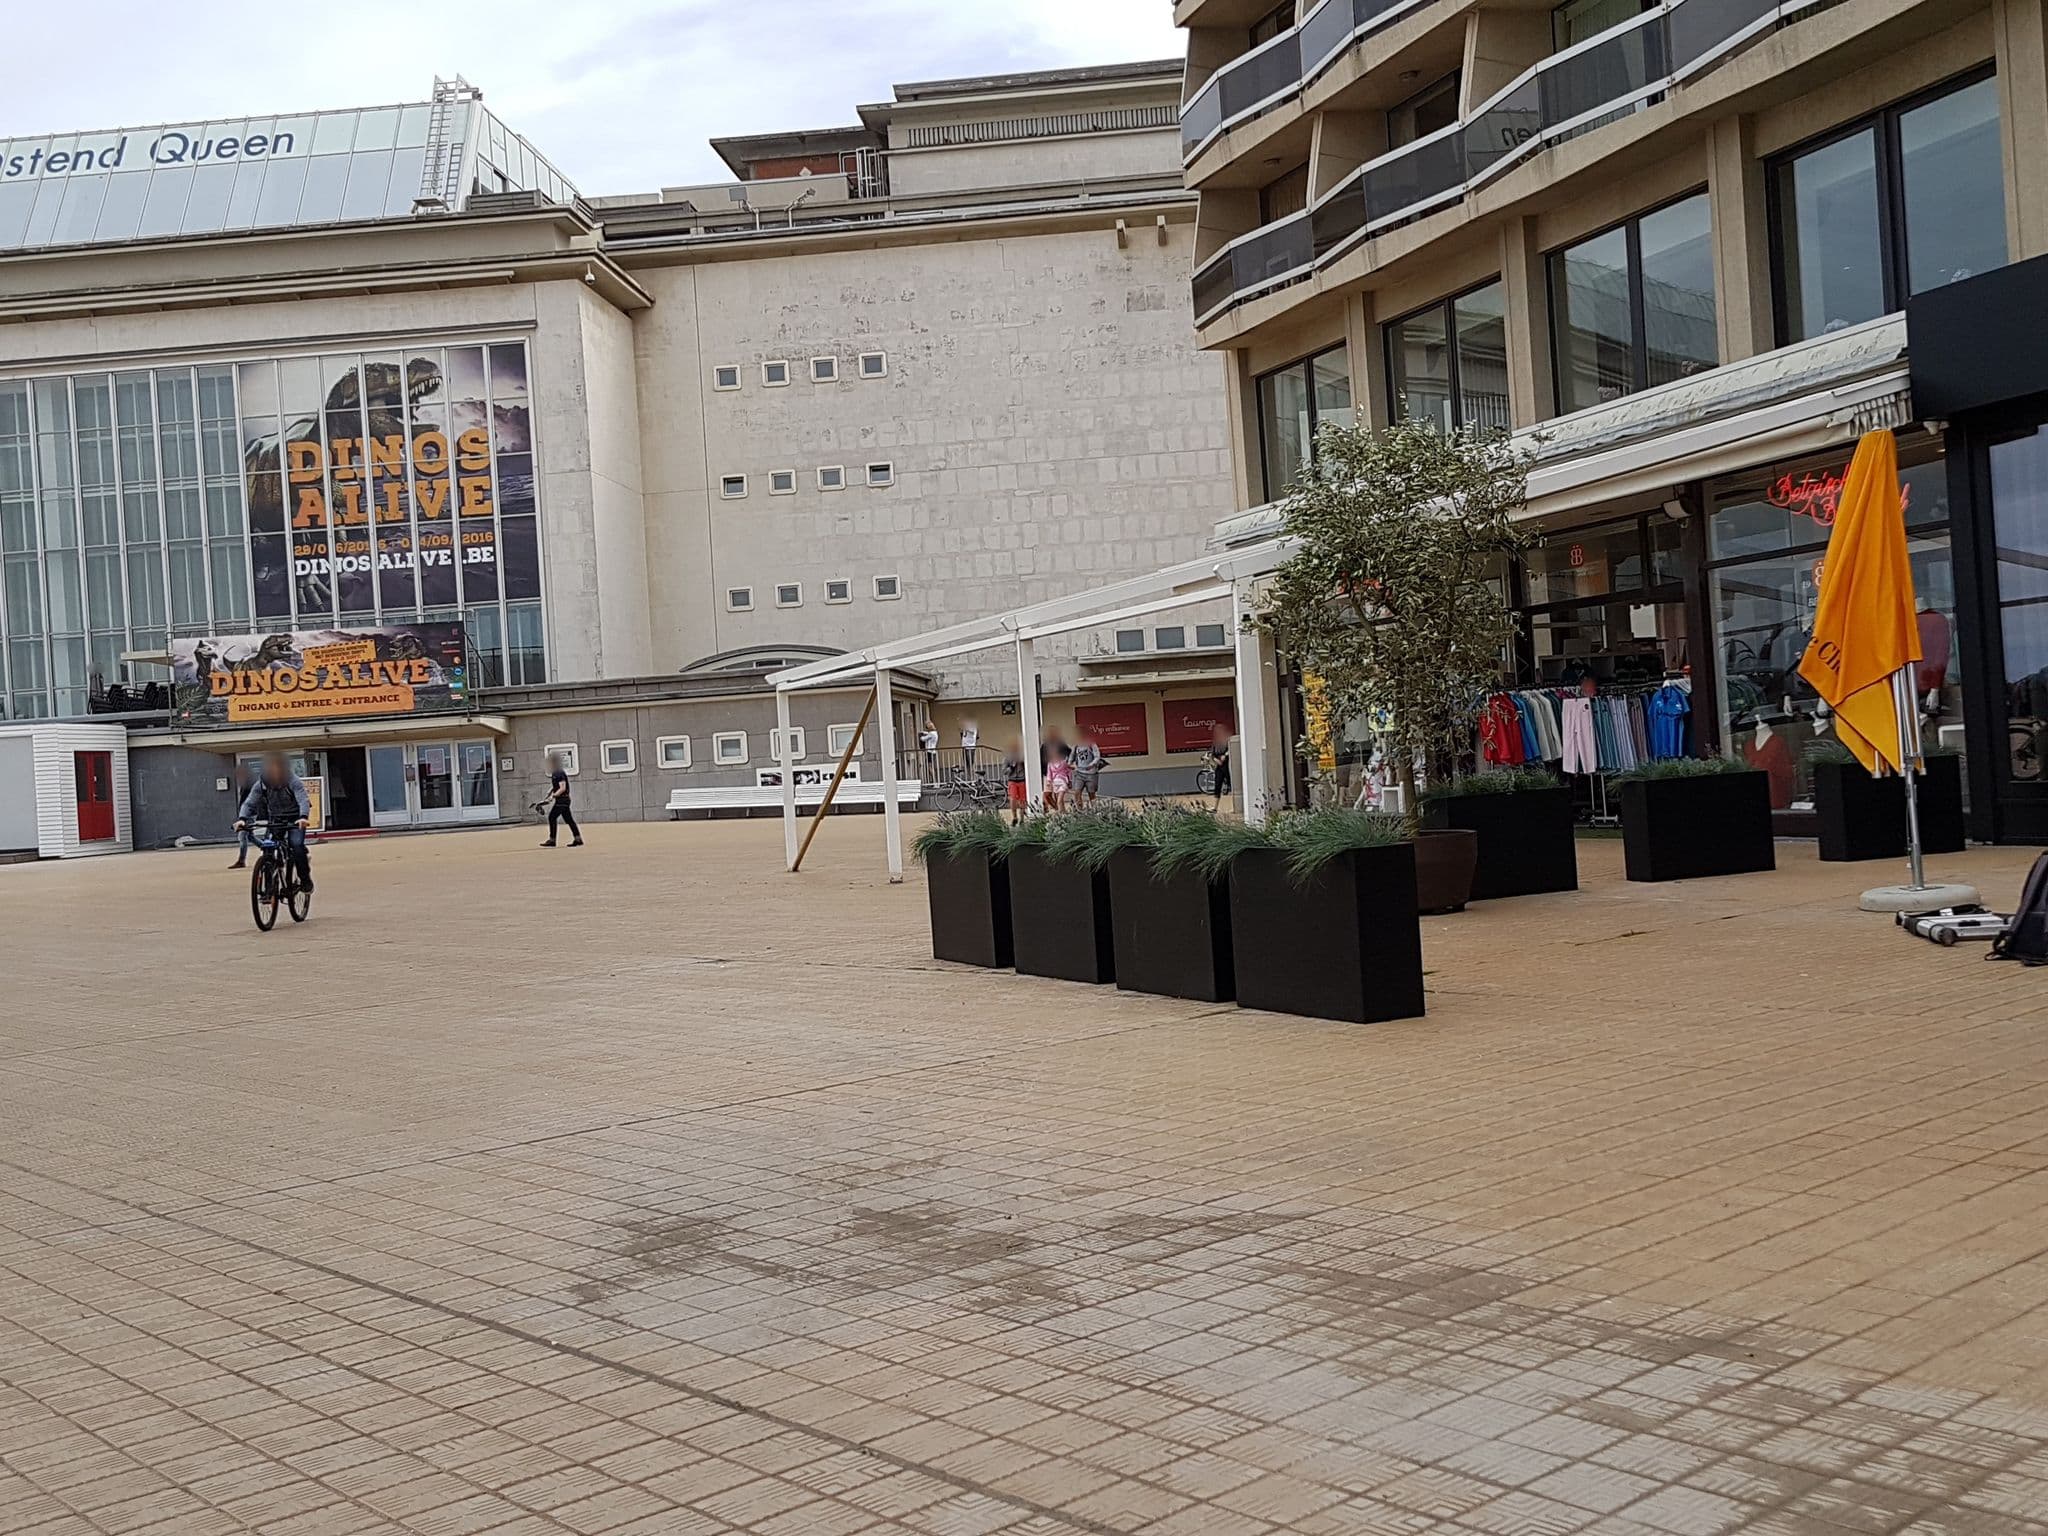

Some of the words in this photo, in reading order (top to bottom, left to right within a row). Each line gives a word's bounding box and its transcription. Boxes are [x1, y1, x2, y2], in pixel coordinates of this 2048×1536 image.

[0, 136, 128, 177] stend
[150, 132, 294, 164] Queen
[287, 427, 491, 484] DINOS
[292, 474, 494, 528] ALIVE
[209, 666, 321, 696] DINOS
[322, 659, 431, 688] ALIVE
[238, 702, 281, 712] INGANG
[342, 693, 401, 705] ENTRANCE
